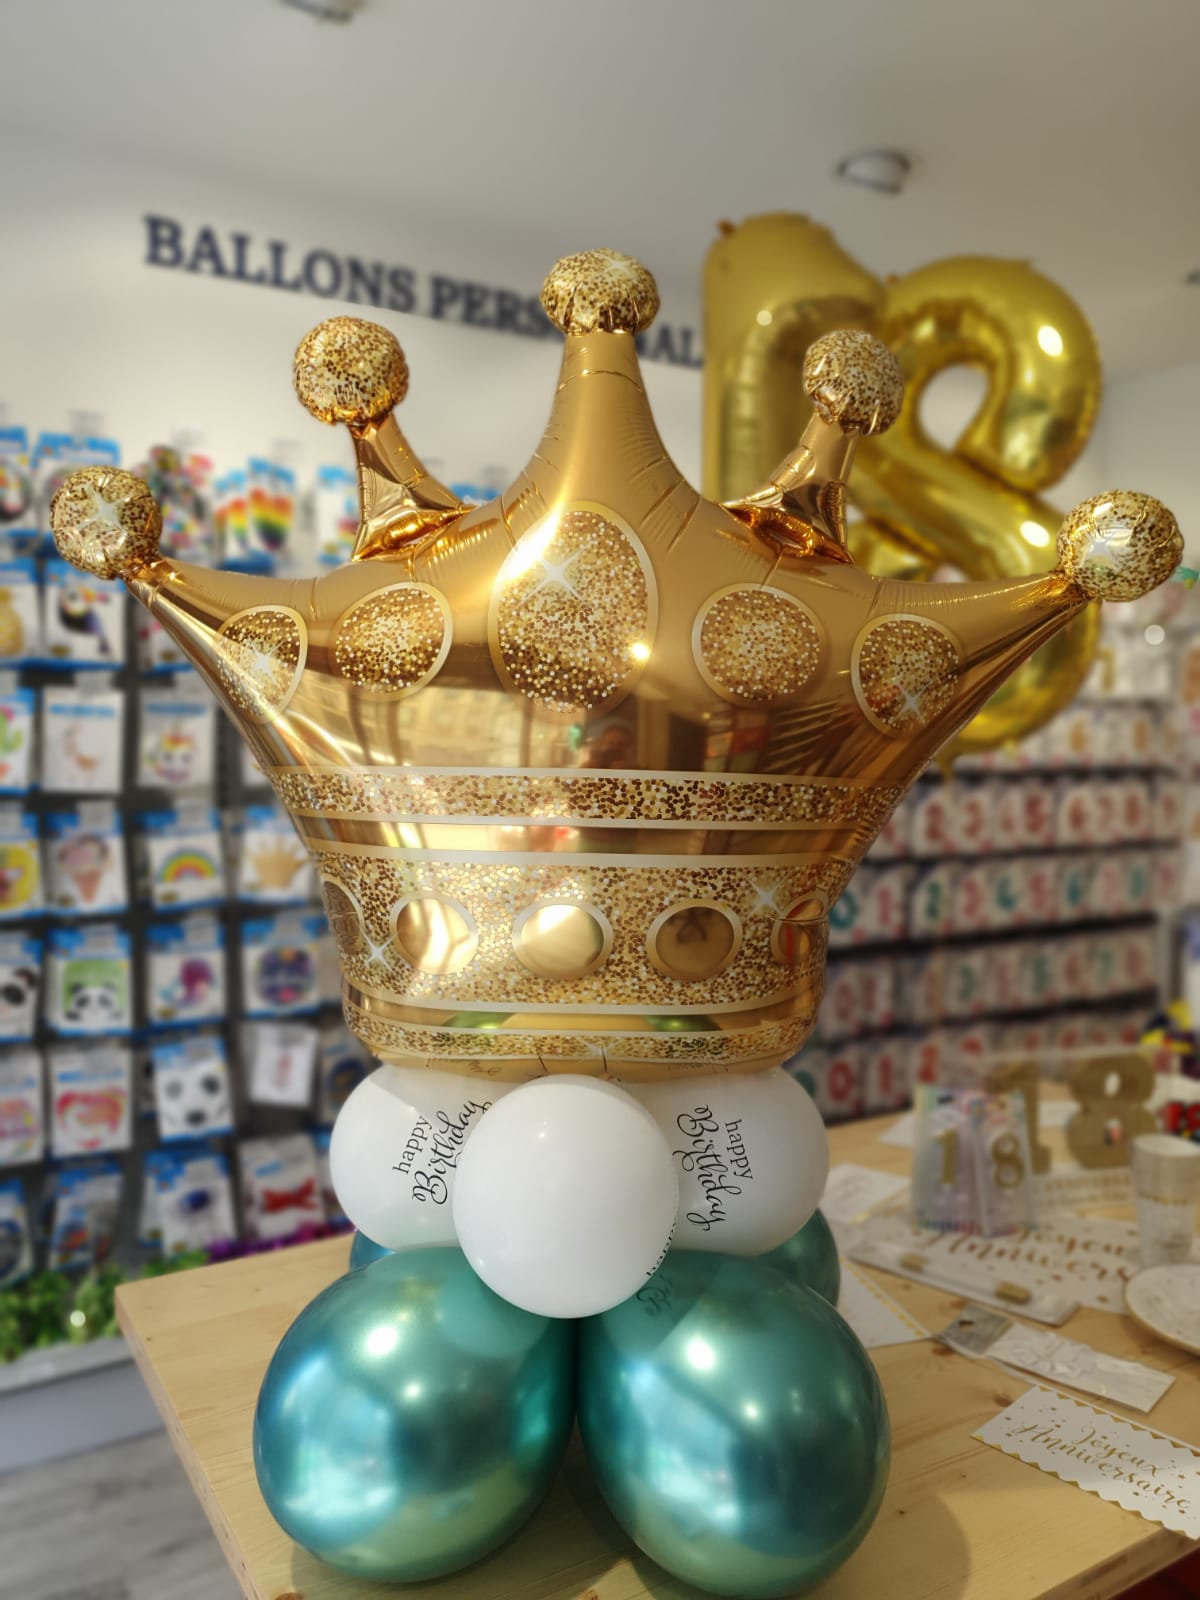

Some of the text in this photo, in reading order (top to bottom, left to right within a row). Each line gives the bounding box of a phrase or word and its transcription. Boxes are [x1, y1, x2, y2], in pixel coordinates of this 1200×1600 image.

[143, 213, 418, 314] BALLONS
[392, 1115, 433, 1174] happy
[411, 1099, 494, 1205] Birthday
[671, 1104, 742, 1232] Birthday
[724, 1118, 754, 1181] happy
[1071, 1425, 1165, 1477] Joyeux
